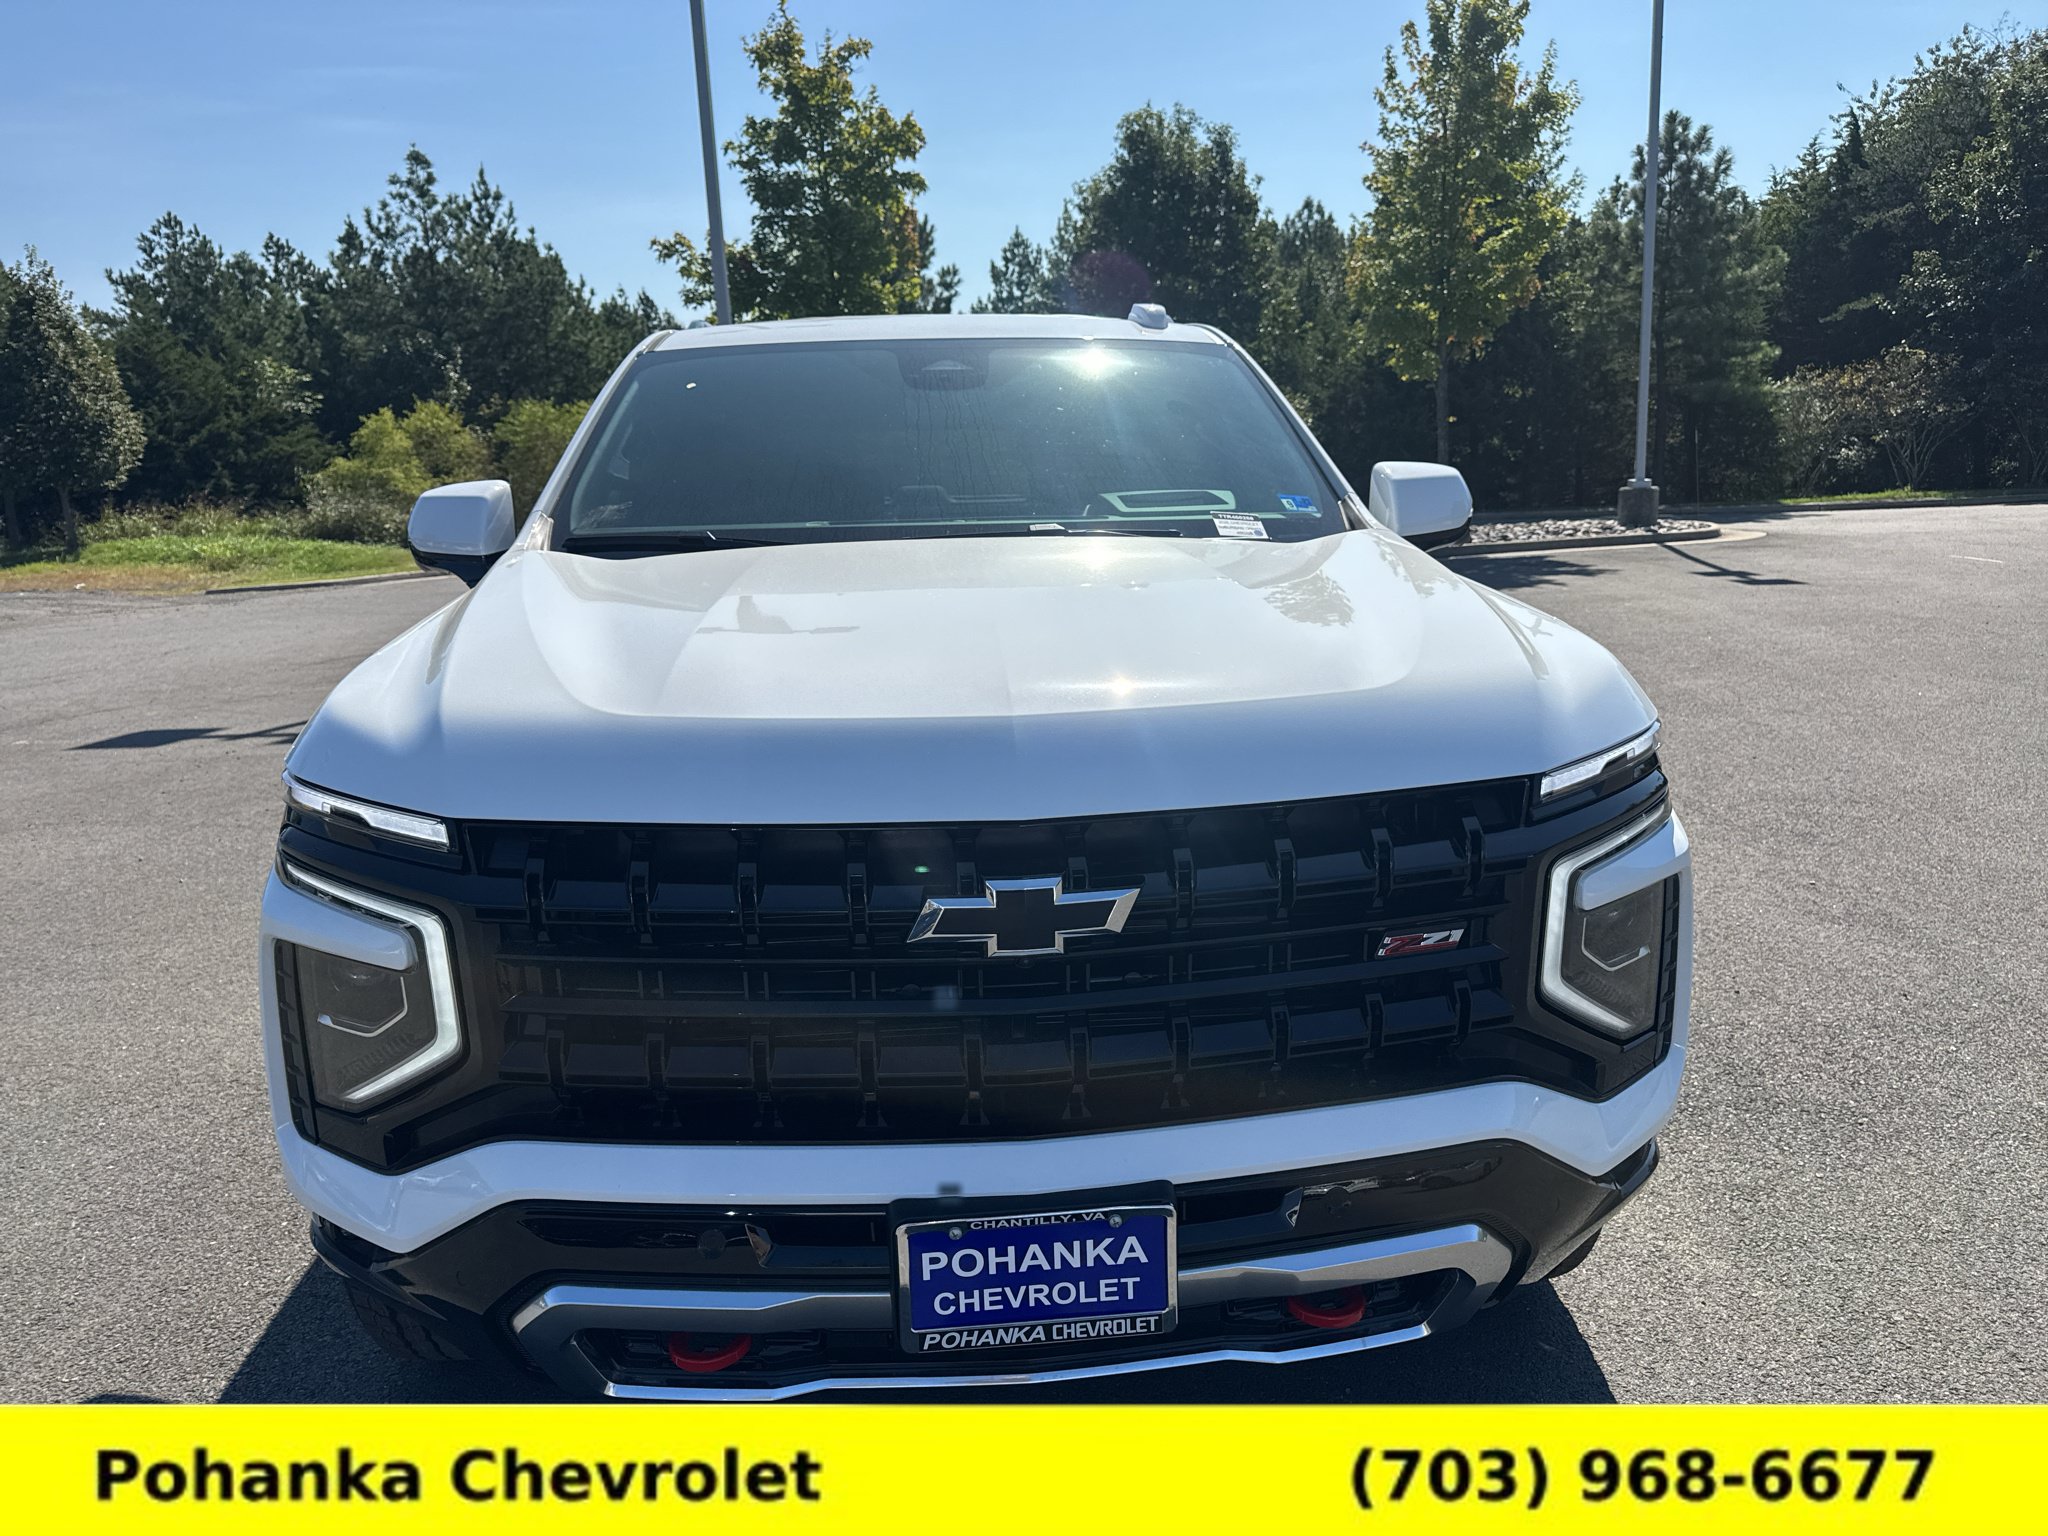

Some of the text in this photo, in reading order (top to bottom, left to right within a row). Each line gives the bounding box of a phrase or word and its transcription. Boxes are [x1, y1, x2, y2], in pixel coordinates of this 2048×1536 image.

[1377, 928, 1465, 956] Z71
[970, 1212, 1107, 1230] CHANTILLY, VA
[921, 1236, 1149, 1281] POHANKA
[933, 1277, 1141, 1316] CHEVROLET
[923, 1317, 1159, 1350] POHANKA CHEVROLET
